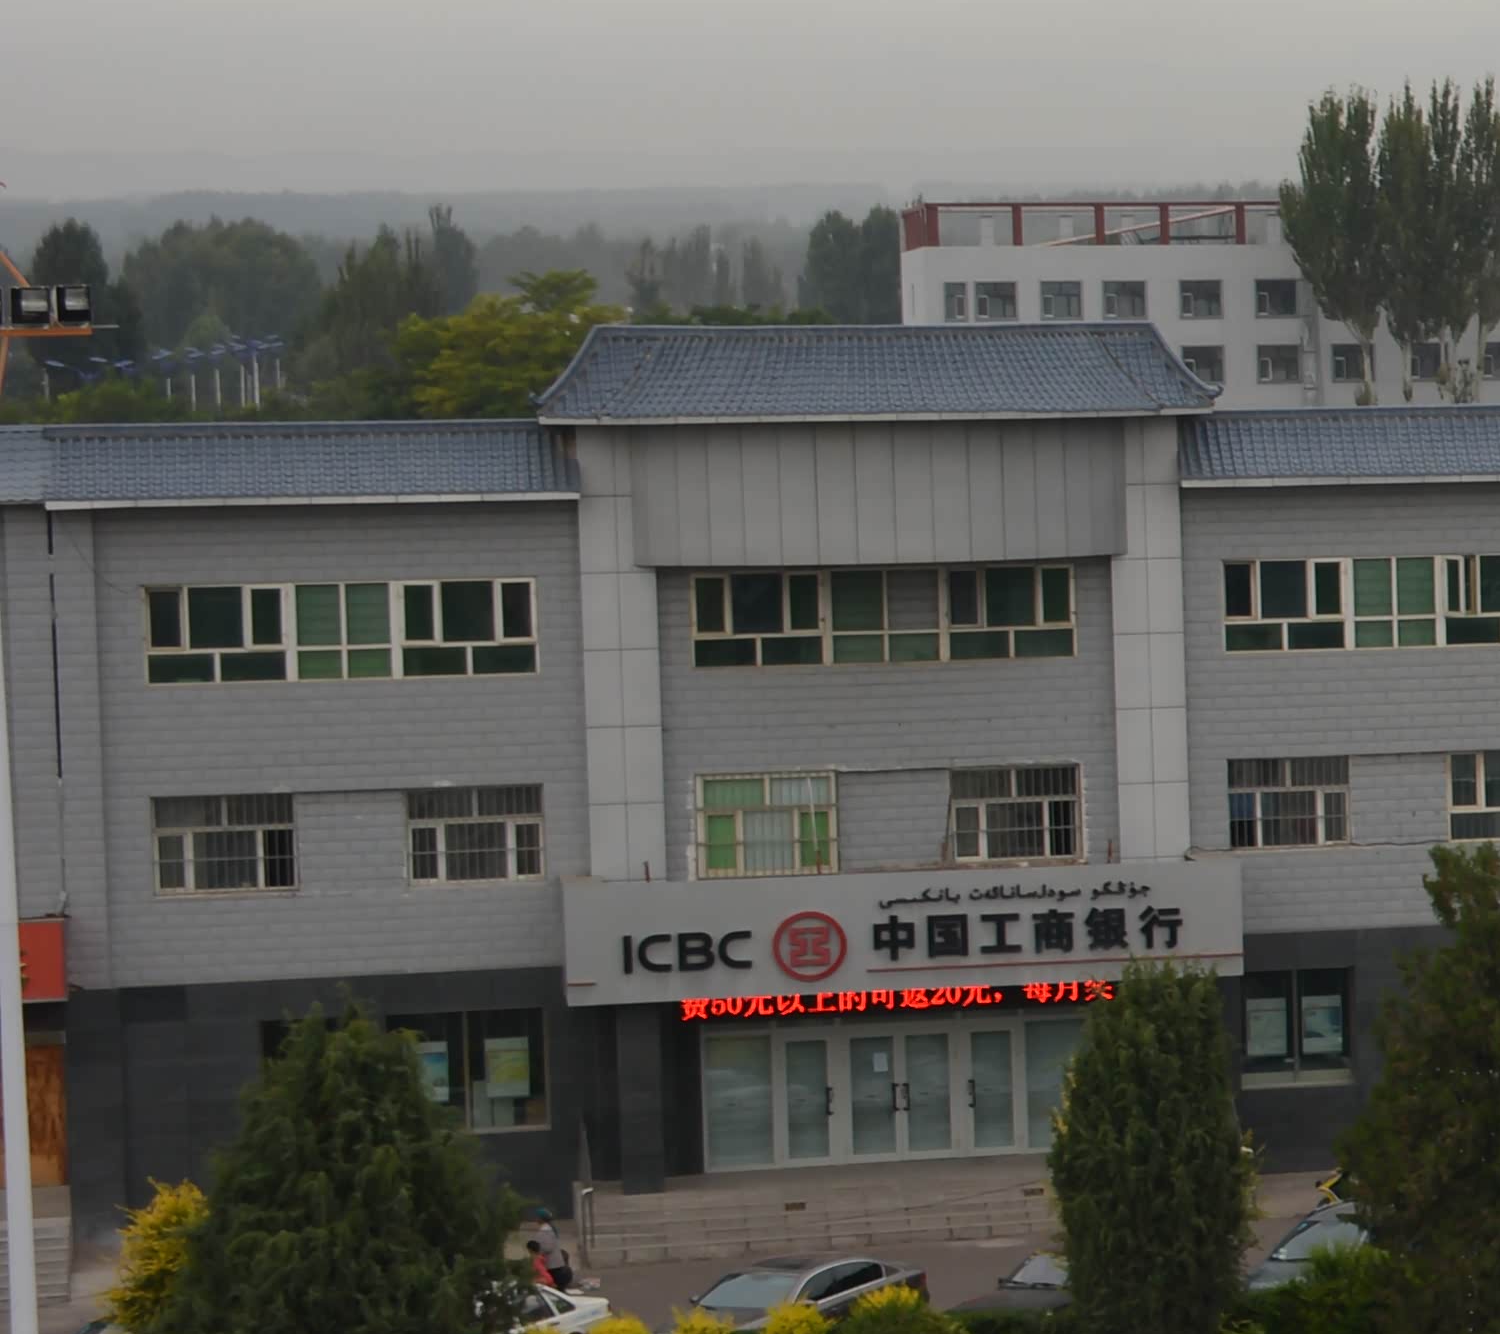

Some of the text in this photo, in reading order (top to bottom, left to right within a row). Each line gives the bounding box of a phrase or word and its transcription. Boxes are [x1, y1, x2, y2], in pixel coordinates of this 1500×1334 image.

[621, 929, 753, 975] ICBC
[872, 905, 1184, 962] 中国工商银行
